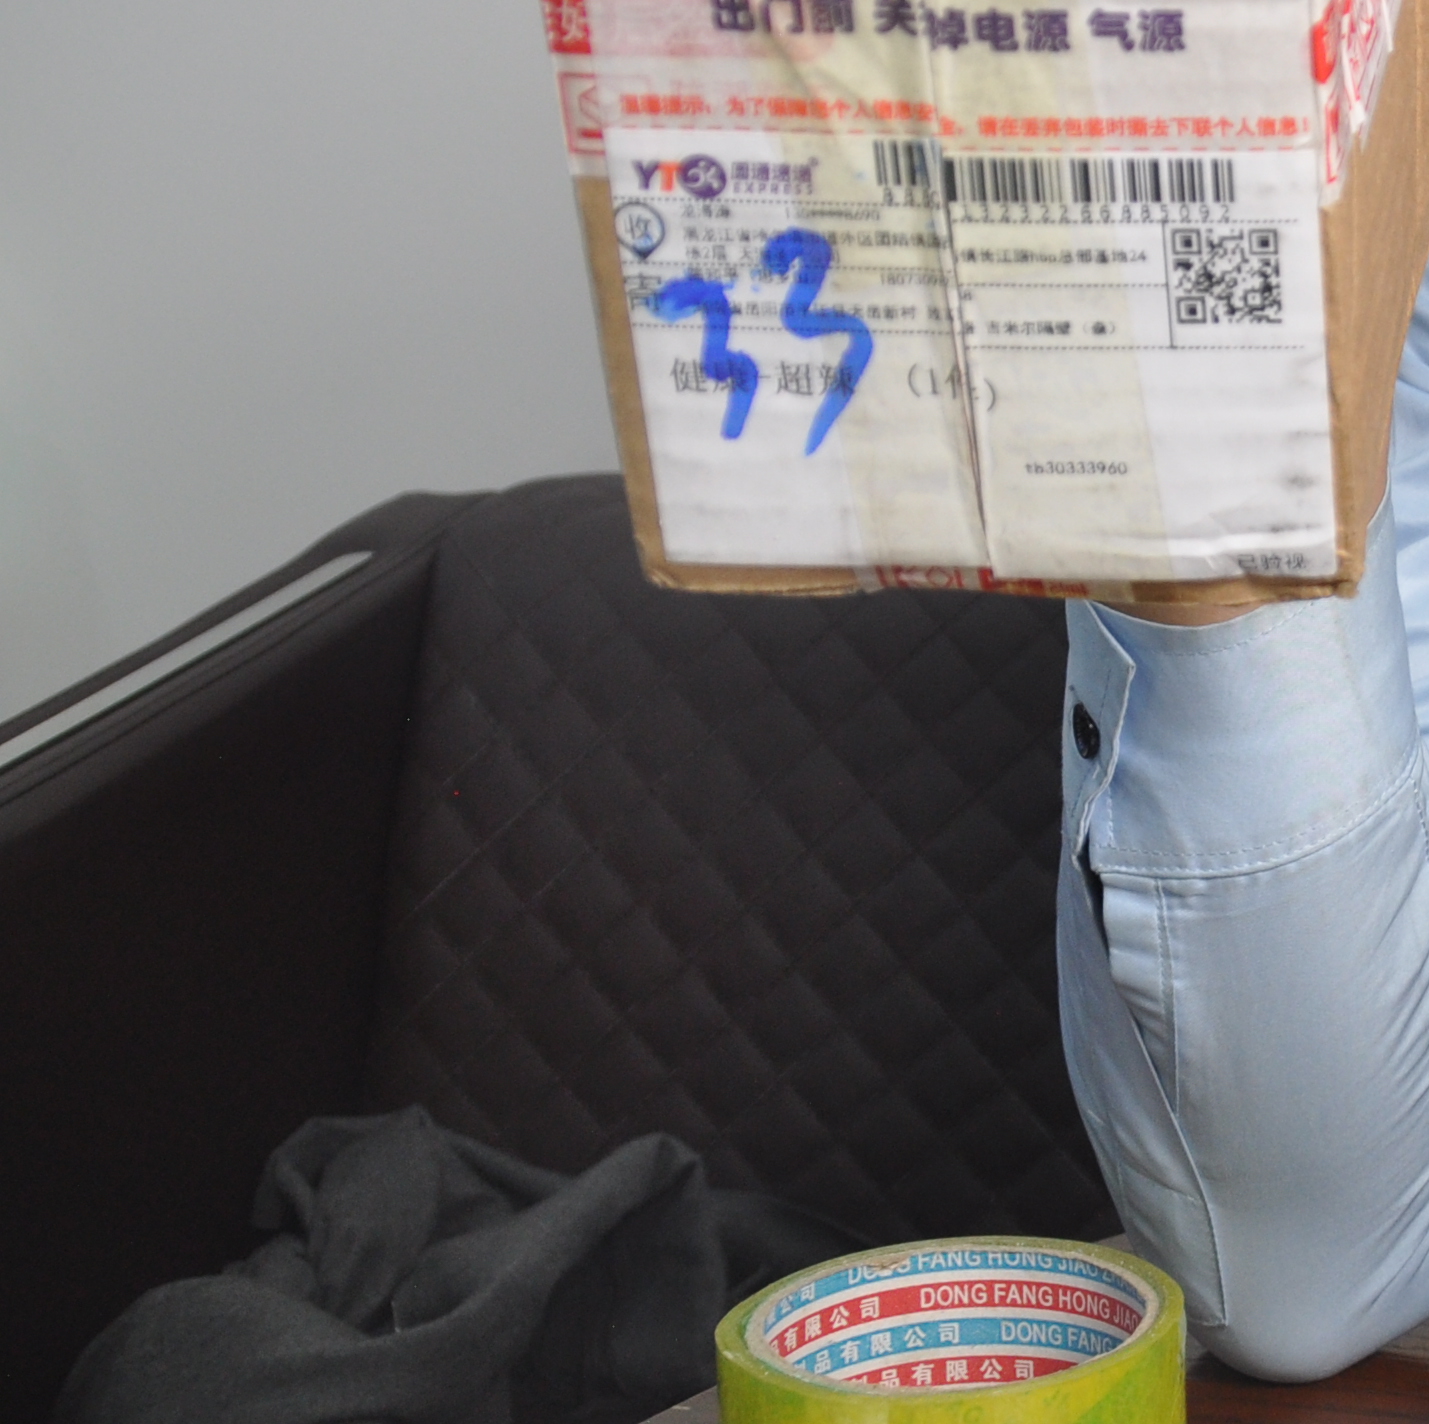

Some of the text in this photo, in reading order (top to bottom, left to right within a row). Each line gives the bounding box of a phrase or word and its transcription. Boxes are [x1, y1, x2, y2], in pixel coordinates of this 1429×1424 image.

[1087, 8, 1186, 52] 气源
[733, 183, 814, 196] EXPRESS
[1025, 460, 1128, 477] tb30333960
[917, 1251, 982, 1271] FANG
[988, 1251, 1053, 1269] HONG
[919, 1283, 988, 1310] DONG
[993, 1282, 1054, 1307] FANG
[1058, 1288, 1111, 1320] HONG
[1001, 1320, 1114, 1356] DONG FANG
